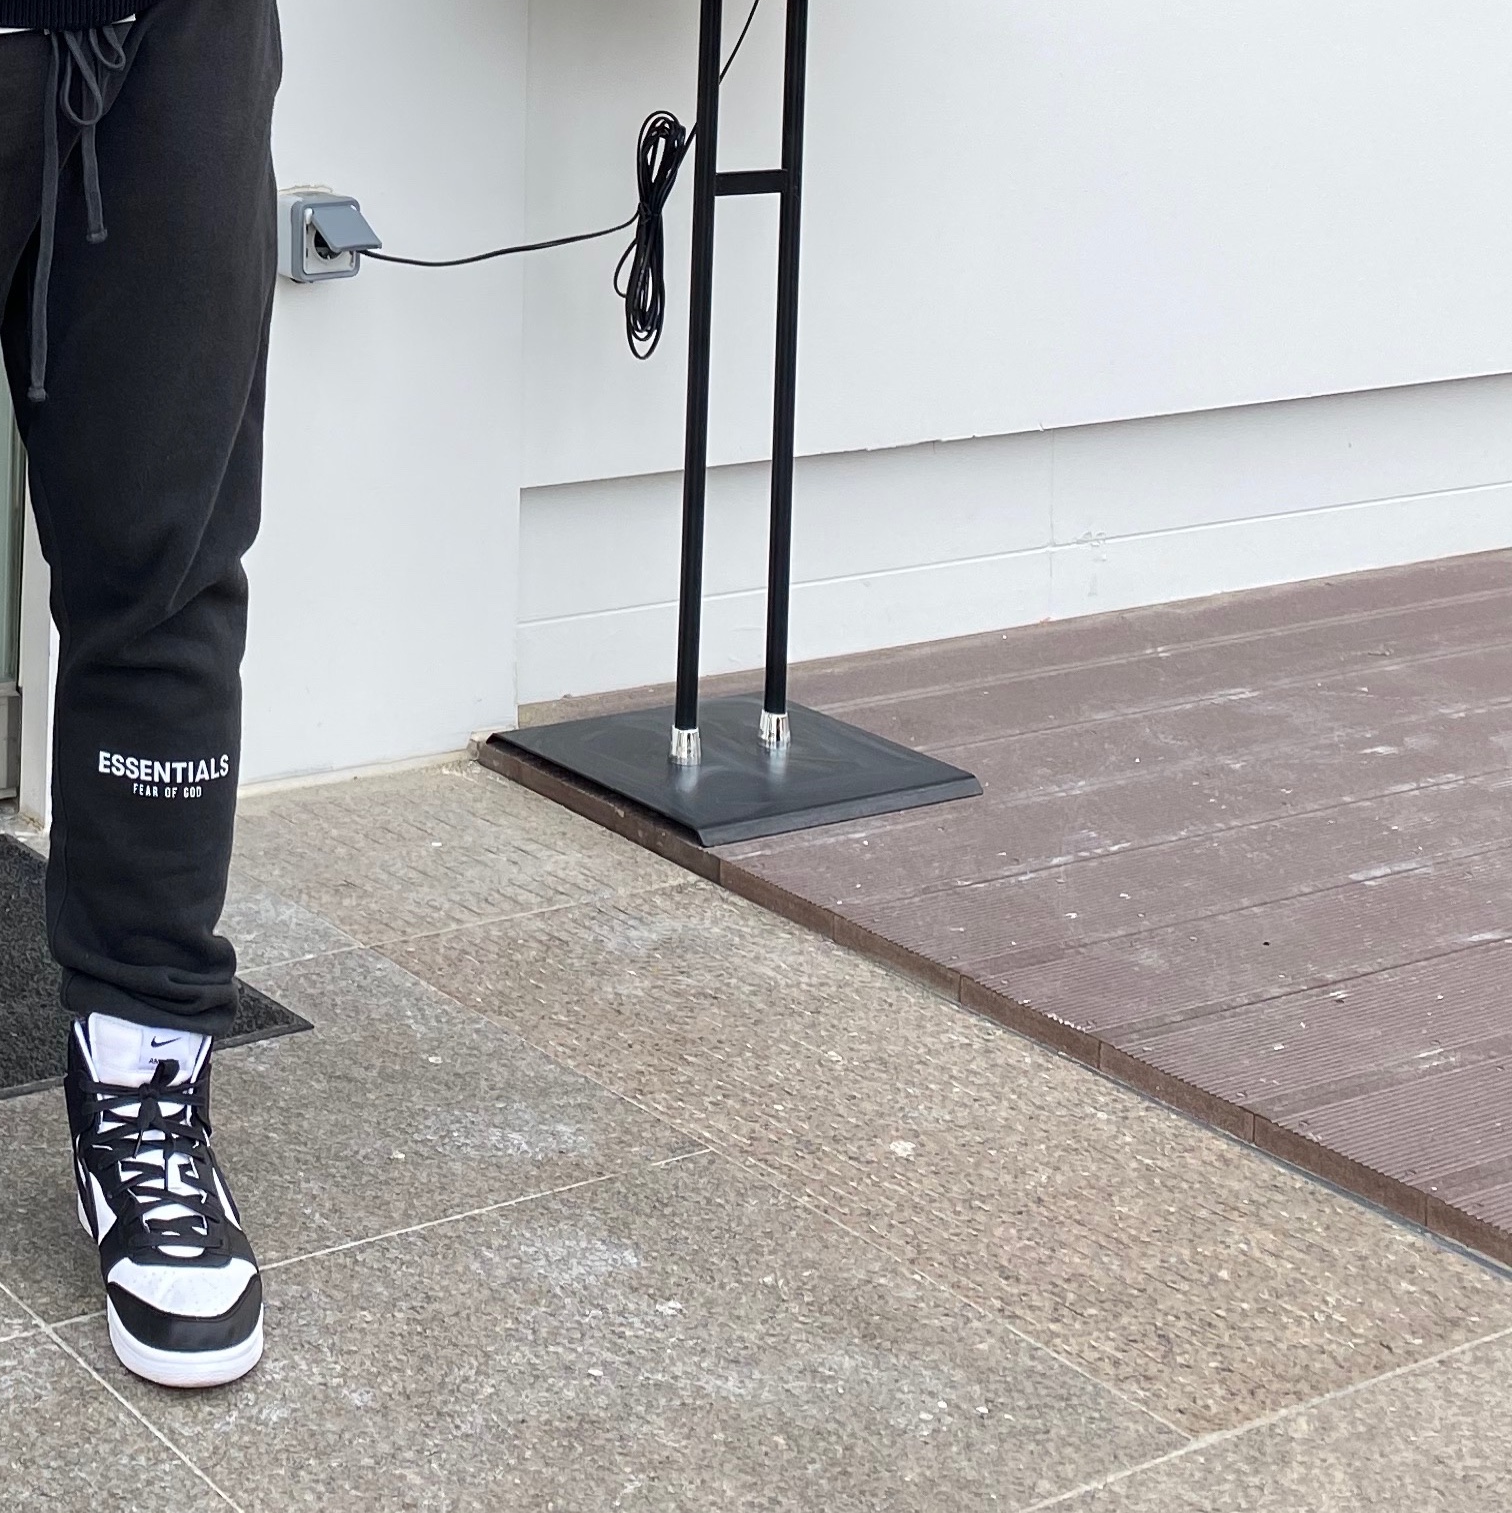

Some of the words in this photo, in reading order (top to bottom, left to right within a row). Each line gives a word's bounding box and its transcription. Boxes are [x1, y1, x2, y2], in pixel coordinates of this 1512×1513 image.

[98, 750, 230, 784] ESSENTIALS
[133, 783, 159, 798] FEAR
[164, 787, 178, 799] OF
[183, 786, 202, 798] GOD
